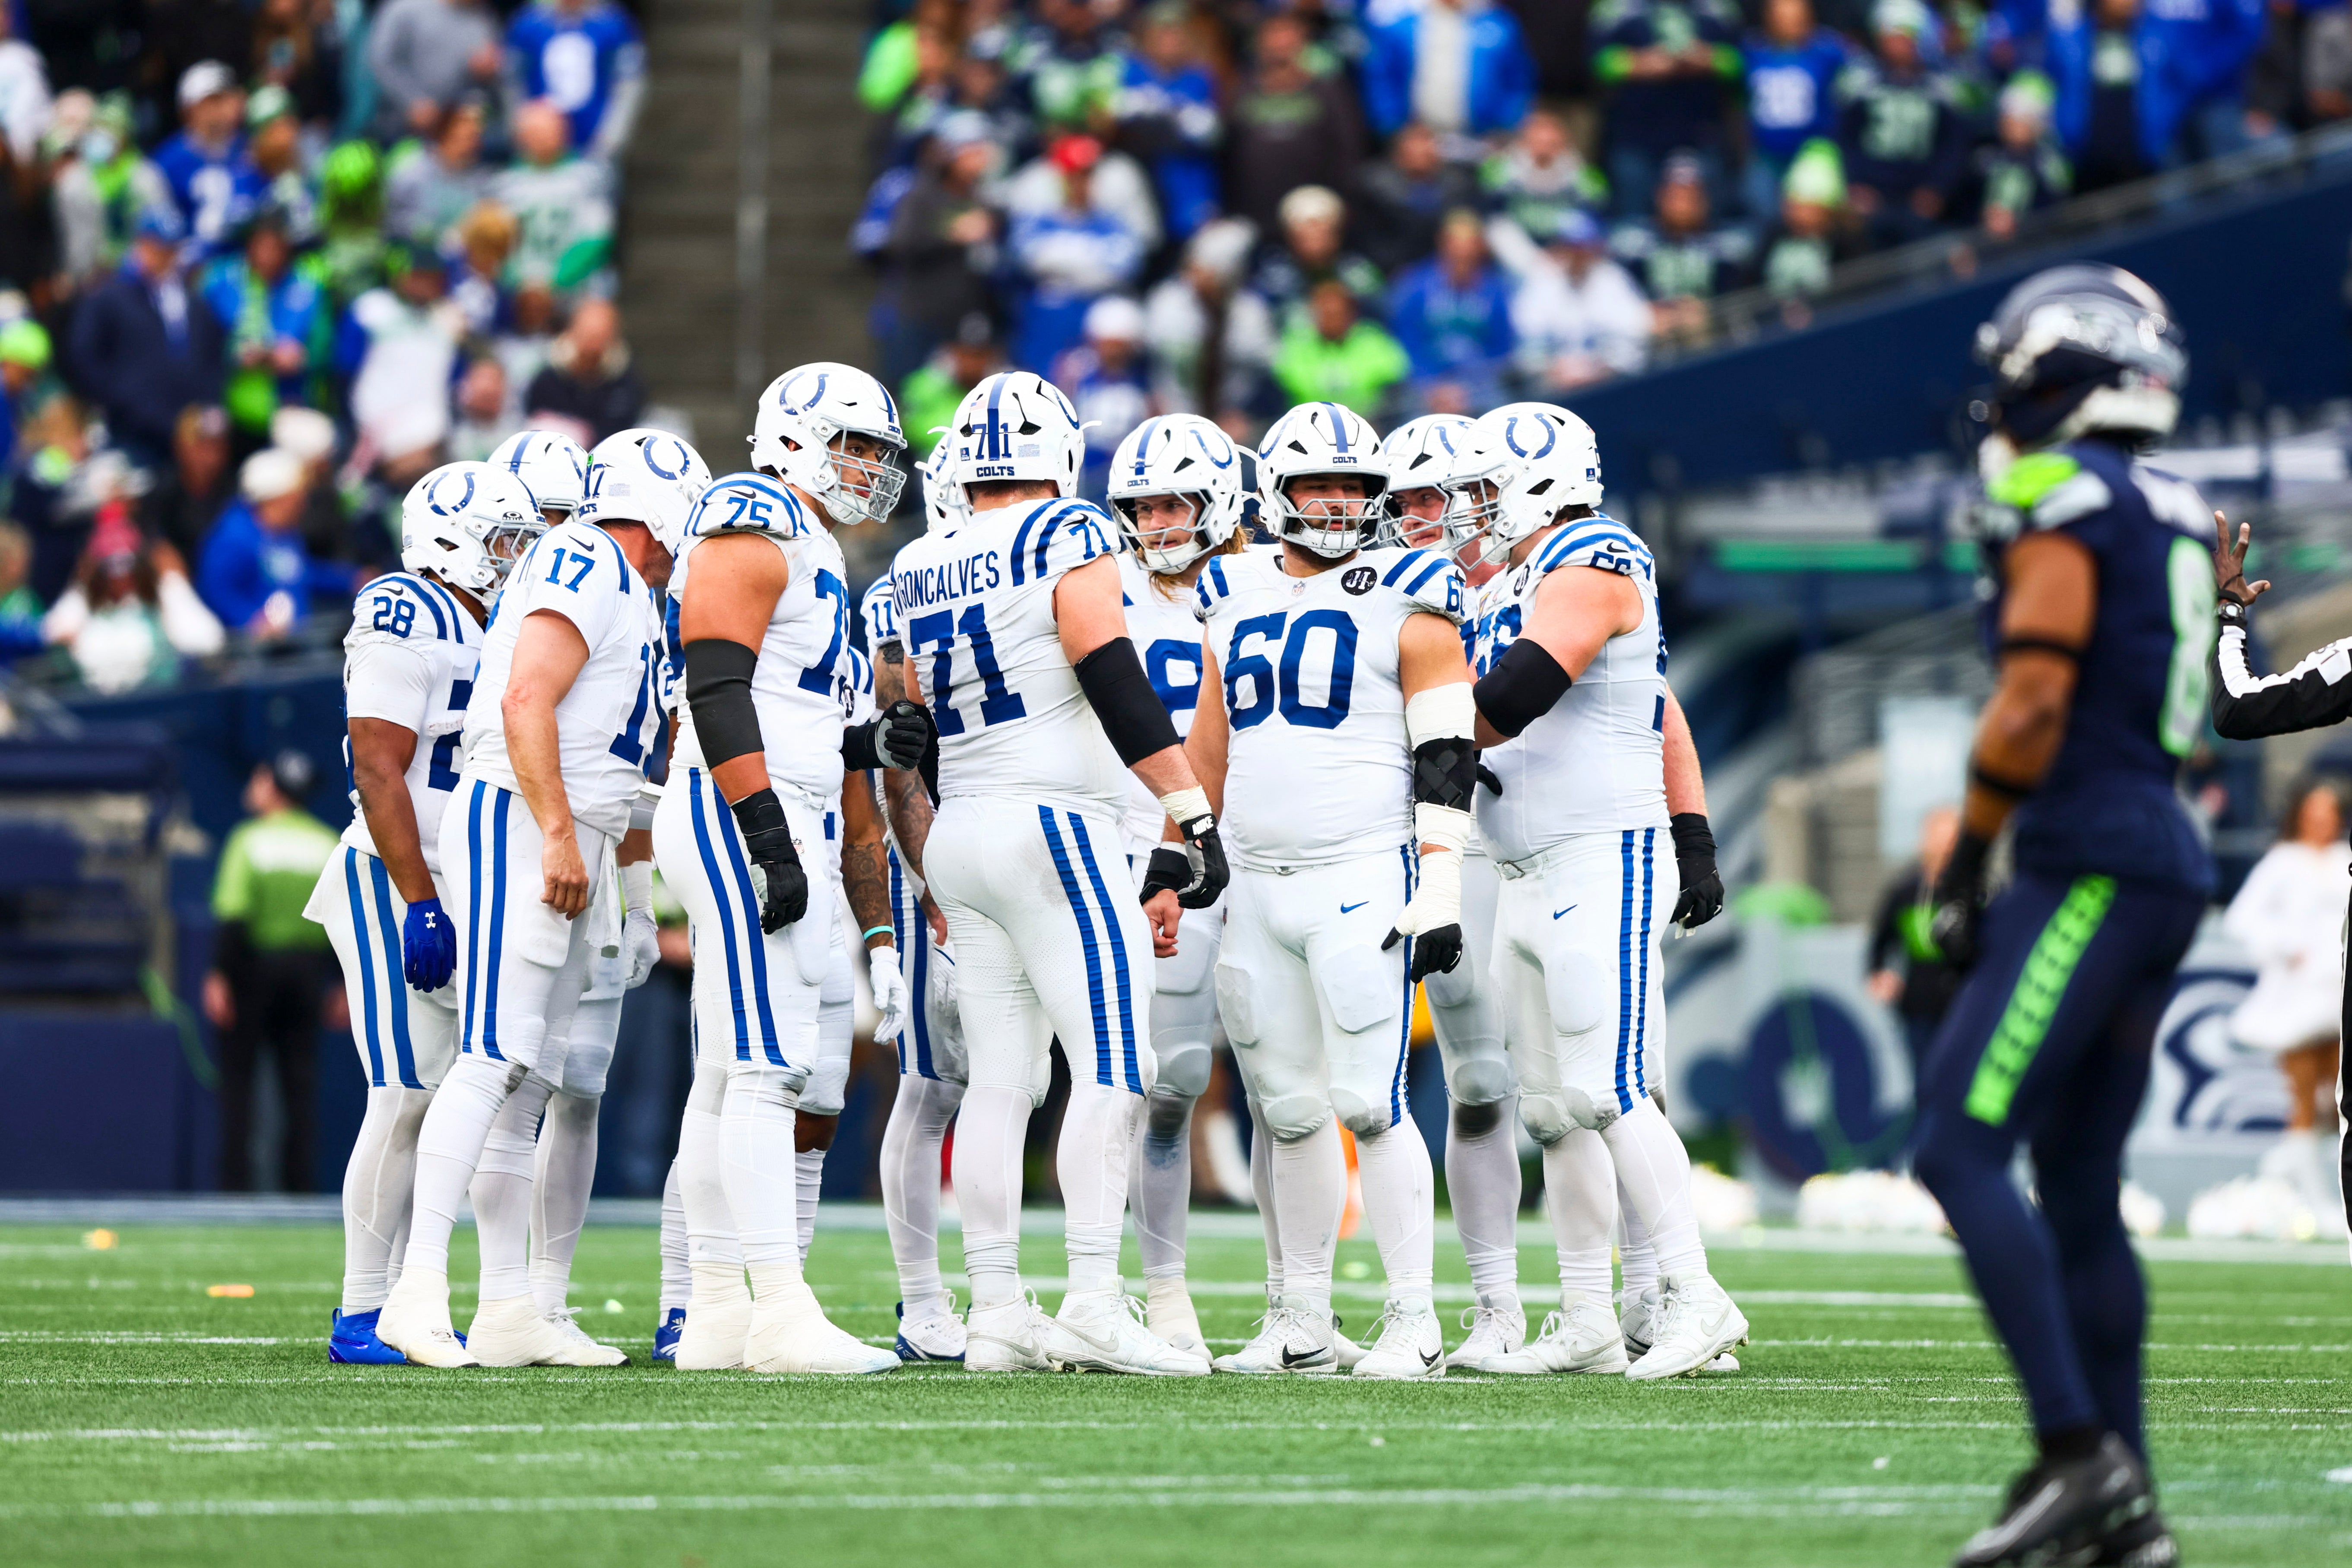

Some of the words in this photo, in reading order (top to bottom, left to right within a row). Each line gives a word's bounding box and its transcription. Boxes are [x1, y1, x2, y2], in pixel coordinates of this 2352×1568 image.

[972, 423, 1012, 460] 71
[976, 466, 1014, 478] COLTS
[721, 497, 773, 529] 75
[1068, 519, 1111, 561] 71
[545, 548, 596, 593] 17
[897, 550, 1000, 609] GONCALVES
[373, 596, 416, 639] 28
[872, 600, 899, 639] 11
[910, 602, 1027, 737] 71
[1224, 609, 1359, 732] 60
[1192, 815, 1214, 835] NIKE
